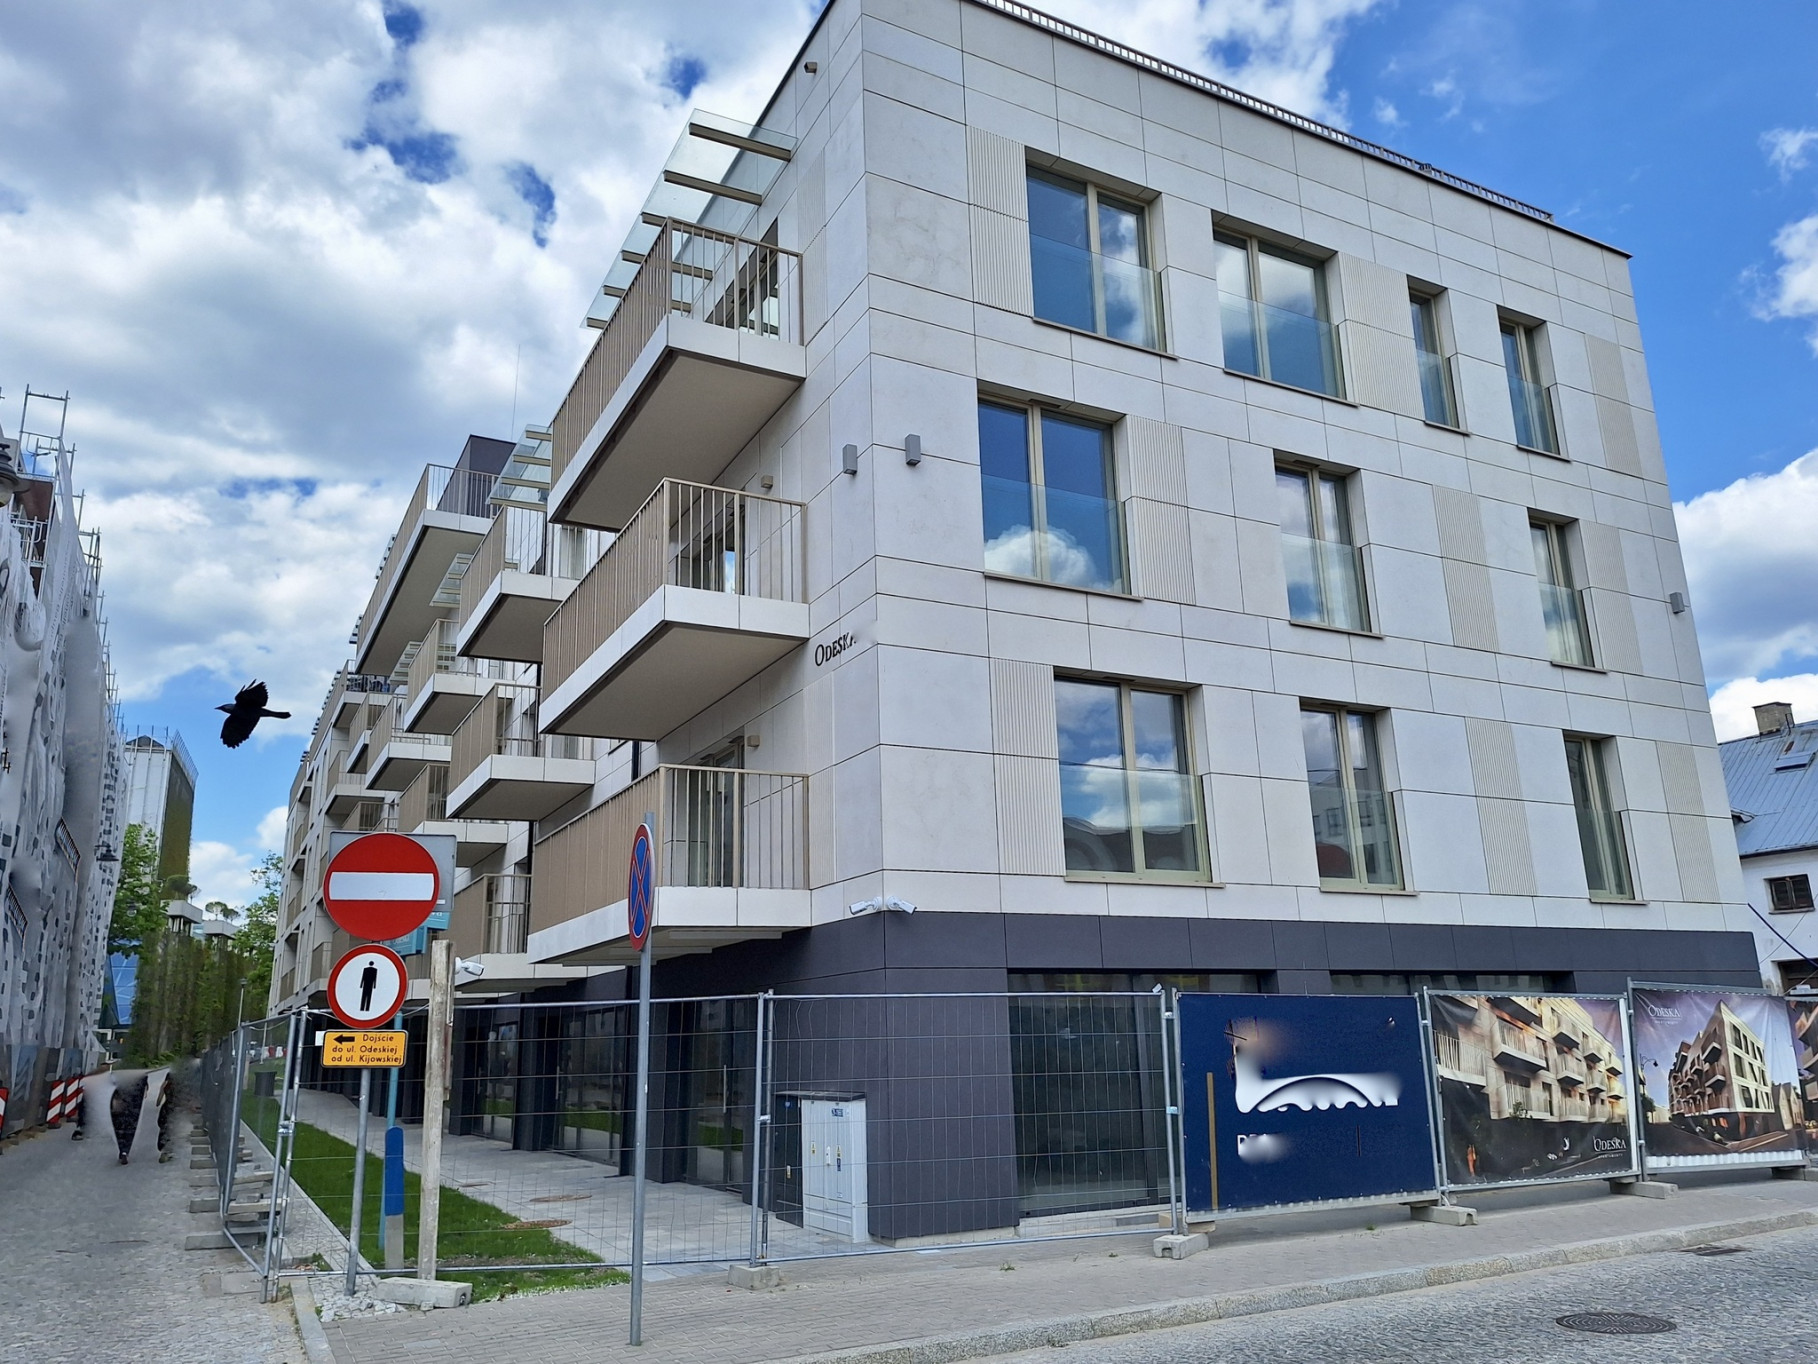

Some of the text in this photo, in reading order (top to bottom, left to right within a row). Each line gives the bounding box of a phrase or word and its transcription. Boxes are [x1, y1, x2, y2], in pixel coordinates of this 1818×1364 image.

[362, 1033, 394, 1044] Dojście
[332, 1045, 398, 1055] do ul. Odeskiej
[345, 1055, 356, 1063] ul.
[359, 1055, 402, 1065] Kijowskiej
[1593, 1138, 1627, 1152] ODESKA
